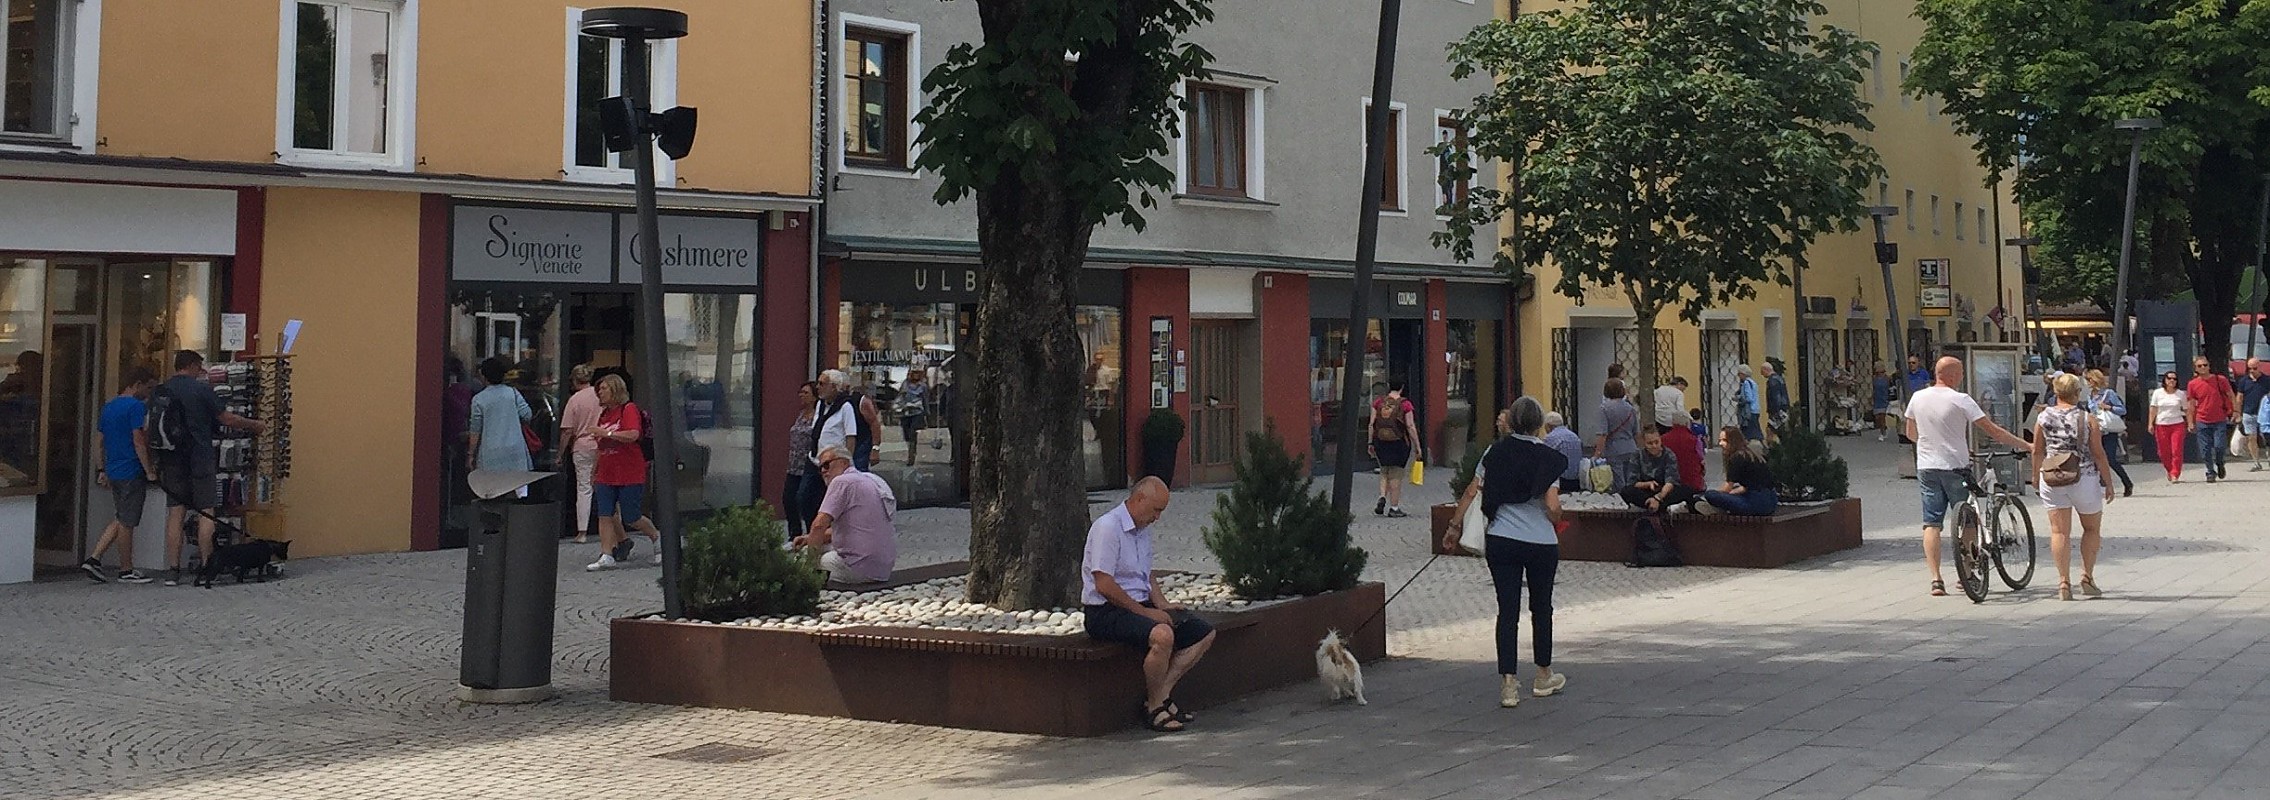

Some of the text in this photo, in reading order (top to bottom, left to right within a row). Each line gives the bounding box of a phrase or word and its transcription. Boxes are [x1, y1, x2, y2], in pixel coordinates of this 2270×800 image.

[485, 214, 583, 266] Signorie
[629, 233, 748, 268] Cshmere
[532, 256, 583, 275] Venete
